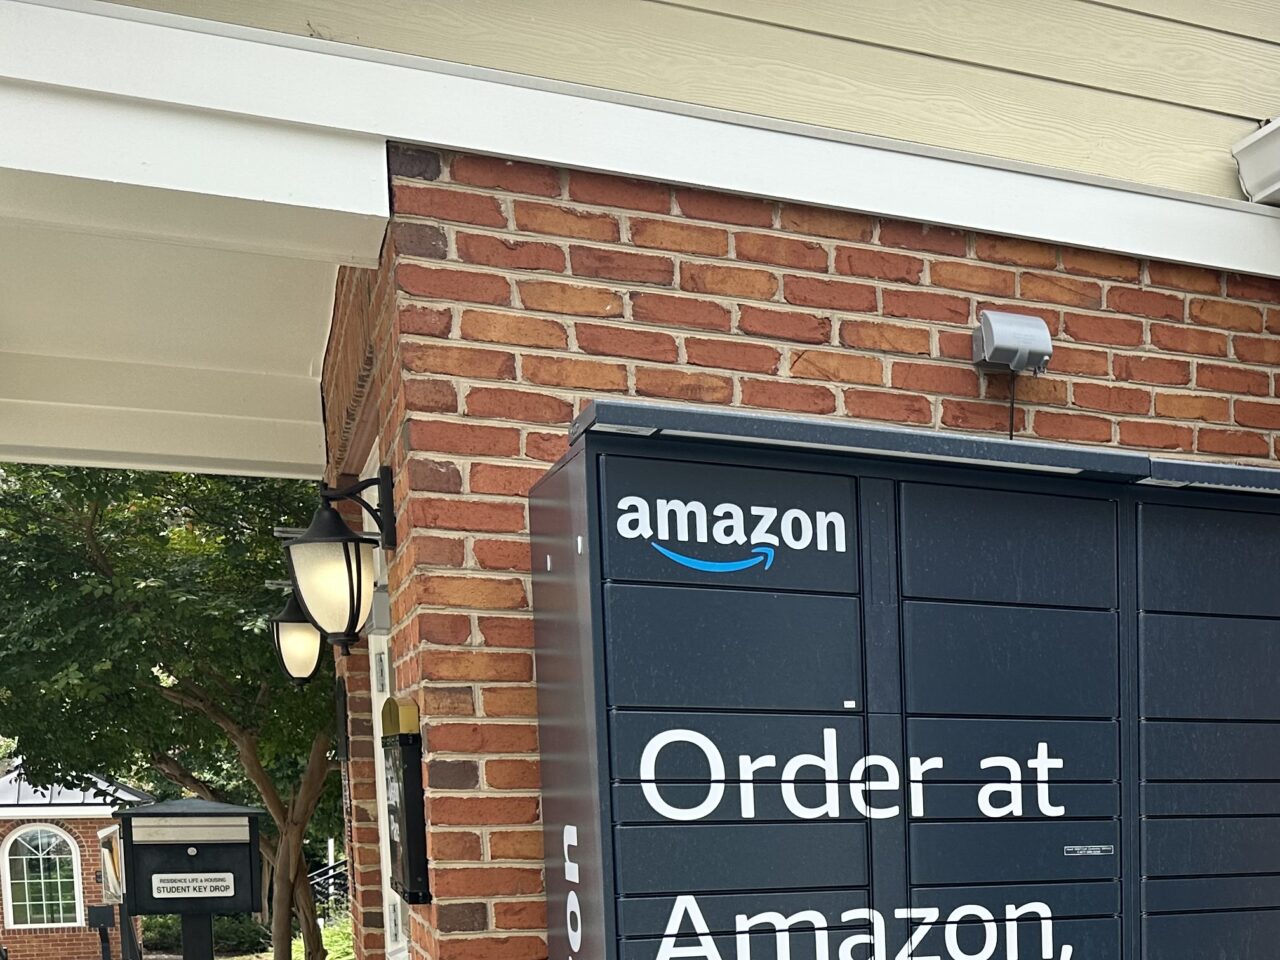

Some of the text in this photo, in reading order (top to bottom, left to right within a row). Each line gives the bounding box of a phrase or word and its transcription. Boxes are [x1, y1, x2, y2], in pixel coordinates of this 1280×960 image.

[616, 496, 846, 553] amazon
[639, 728, 1066, 821] Order at
[156, 884, 231, 894] STUDENT KEY DROP
